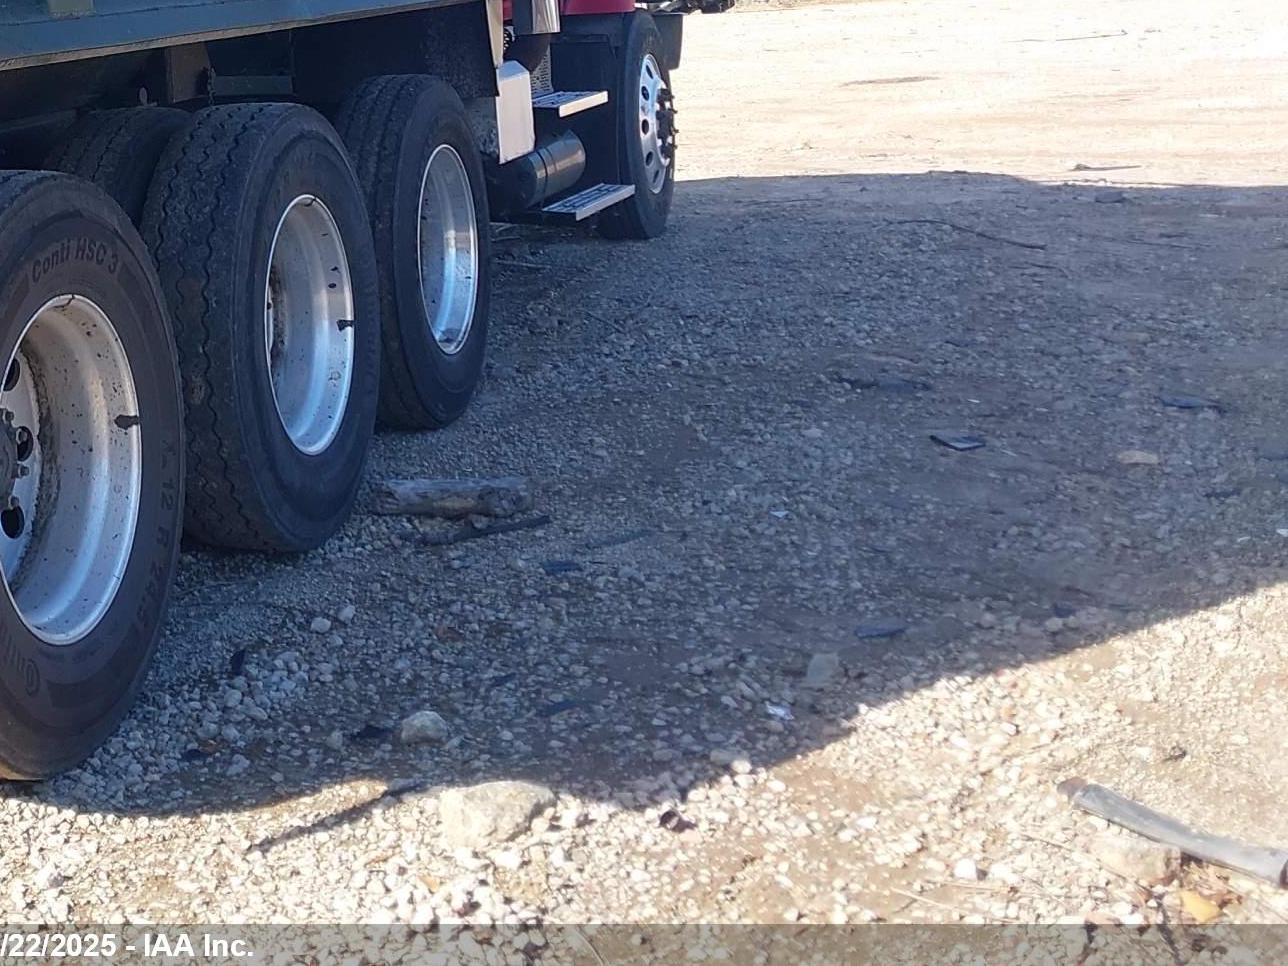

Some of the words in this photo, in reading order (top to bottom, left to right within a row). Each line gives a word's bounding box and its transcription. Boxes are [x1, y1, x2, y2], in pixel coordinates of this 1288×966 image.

[32, 237, 70, 283] Conti
[75, 236, 106, 266] HSC
[108, 247, 119, 275] 3
